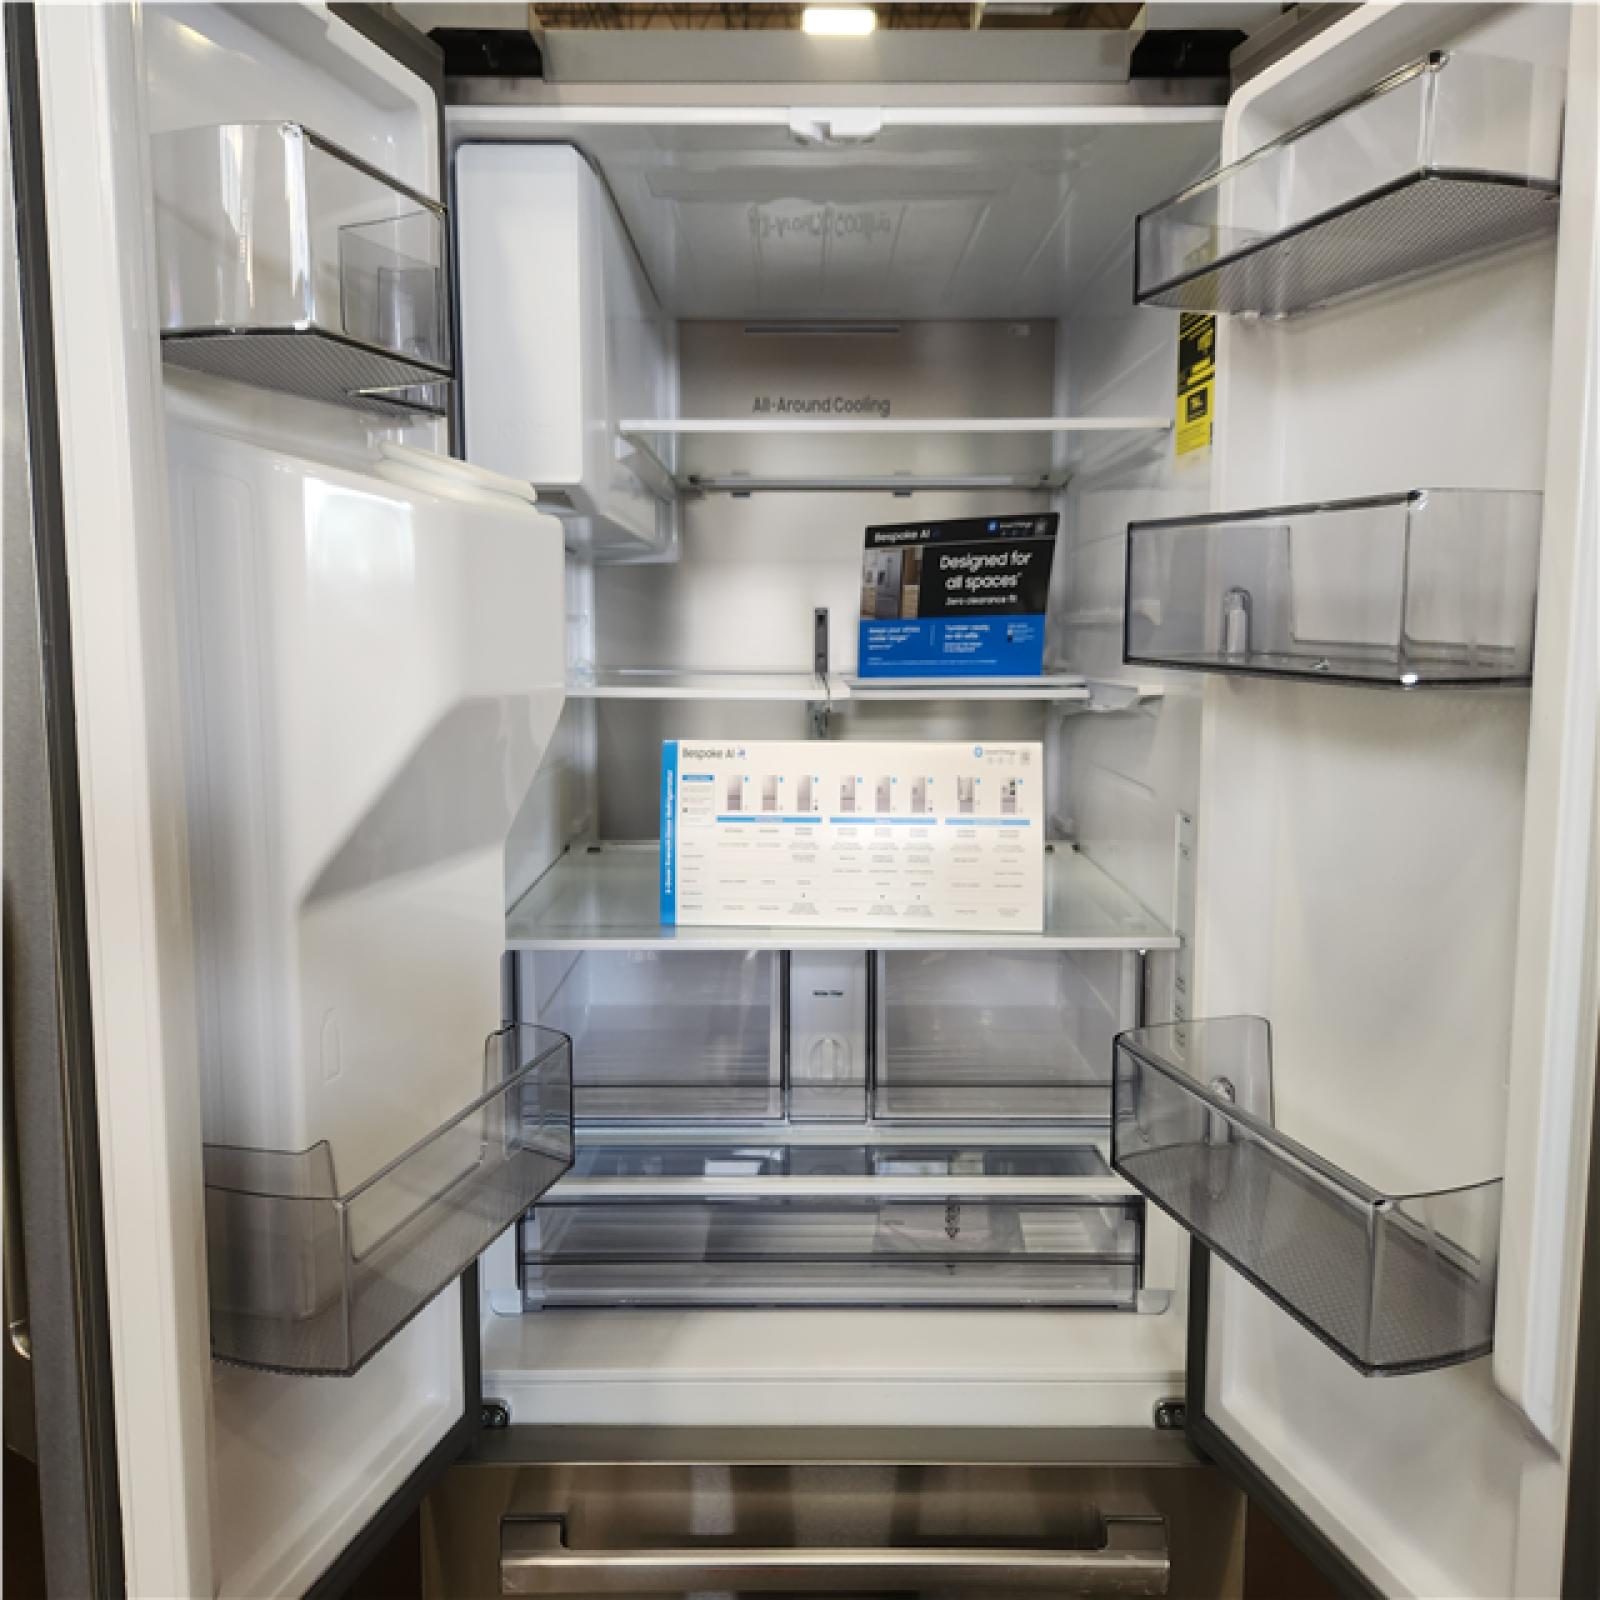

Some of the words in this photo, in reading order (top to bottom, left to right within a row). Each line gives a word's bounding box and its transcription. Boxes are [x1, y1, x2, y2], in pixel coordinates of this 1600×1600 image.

[752, 396, 832, 413] All-Around
[834, 394, 891, 417] Cooling
[940, 552, 1008, 573] Designed
[1010, 550, 1032, 566] for
[945, 574, 963, 591] all
[682, 747, 723, 760] Bespoke
